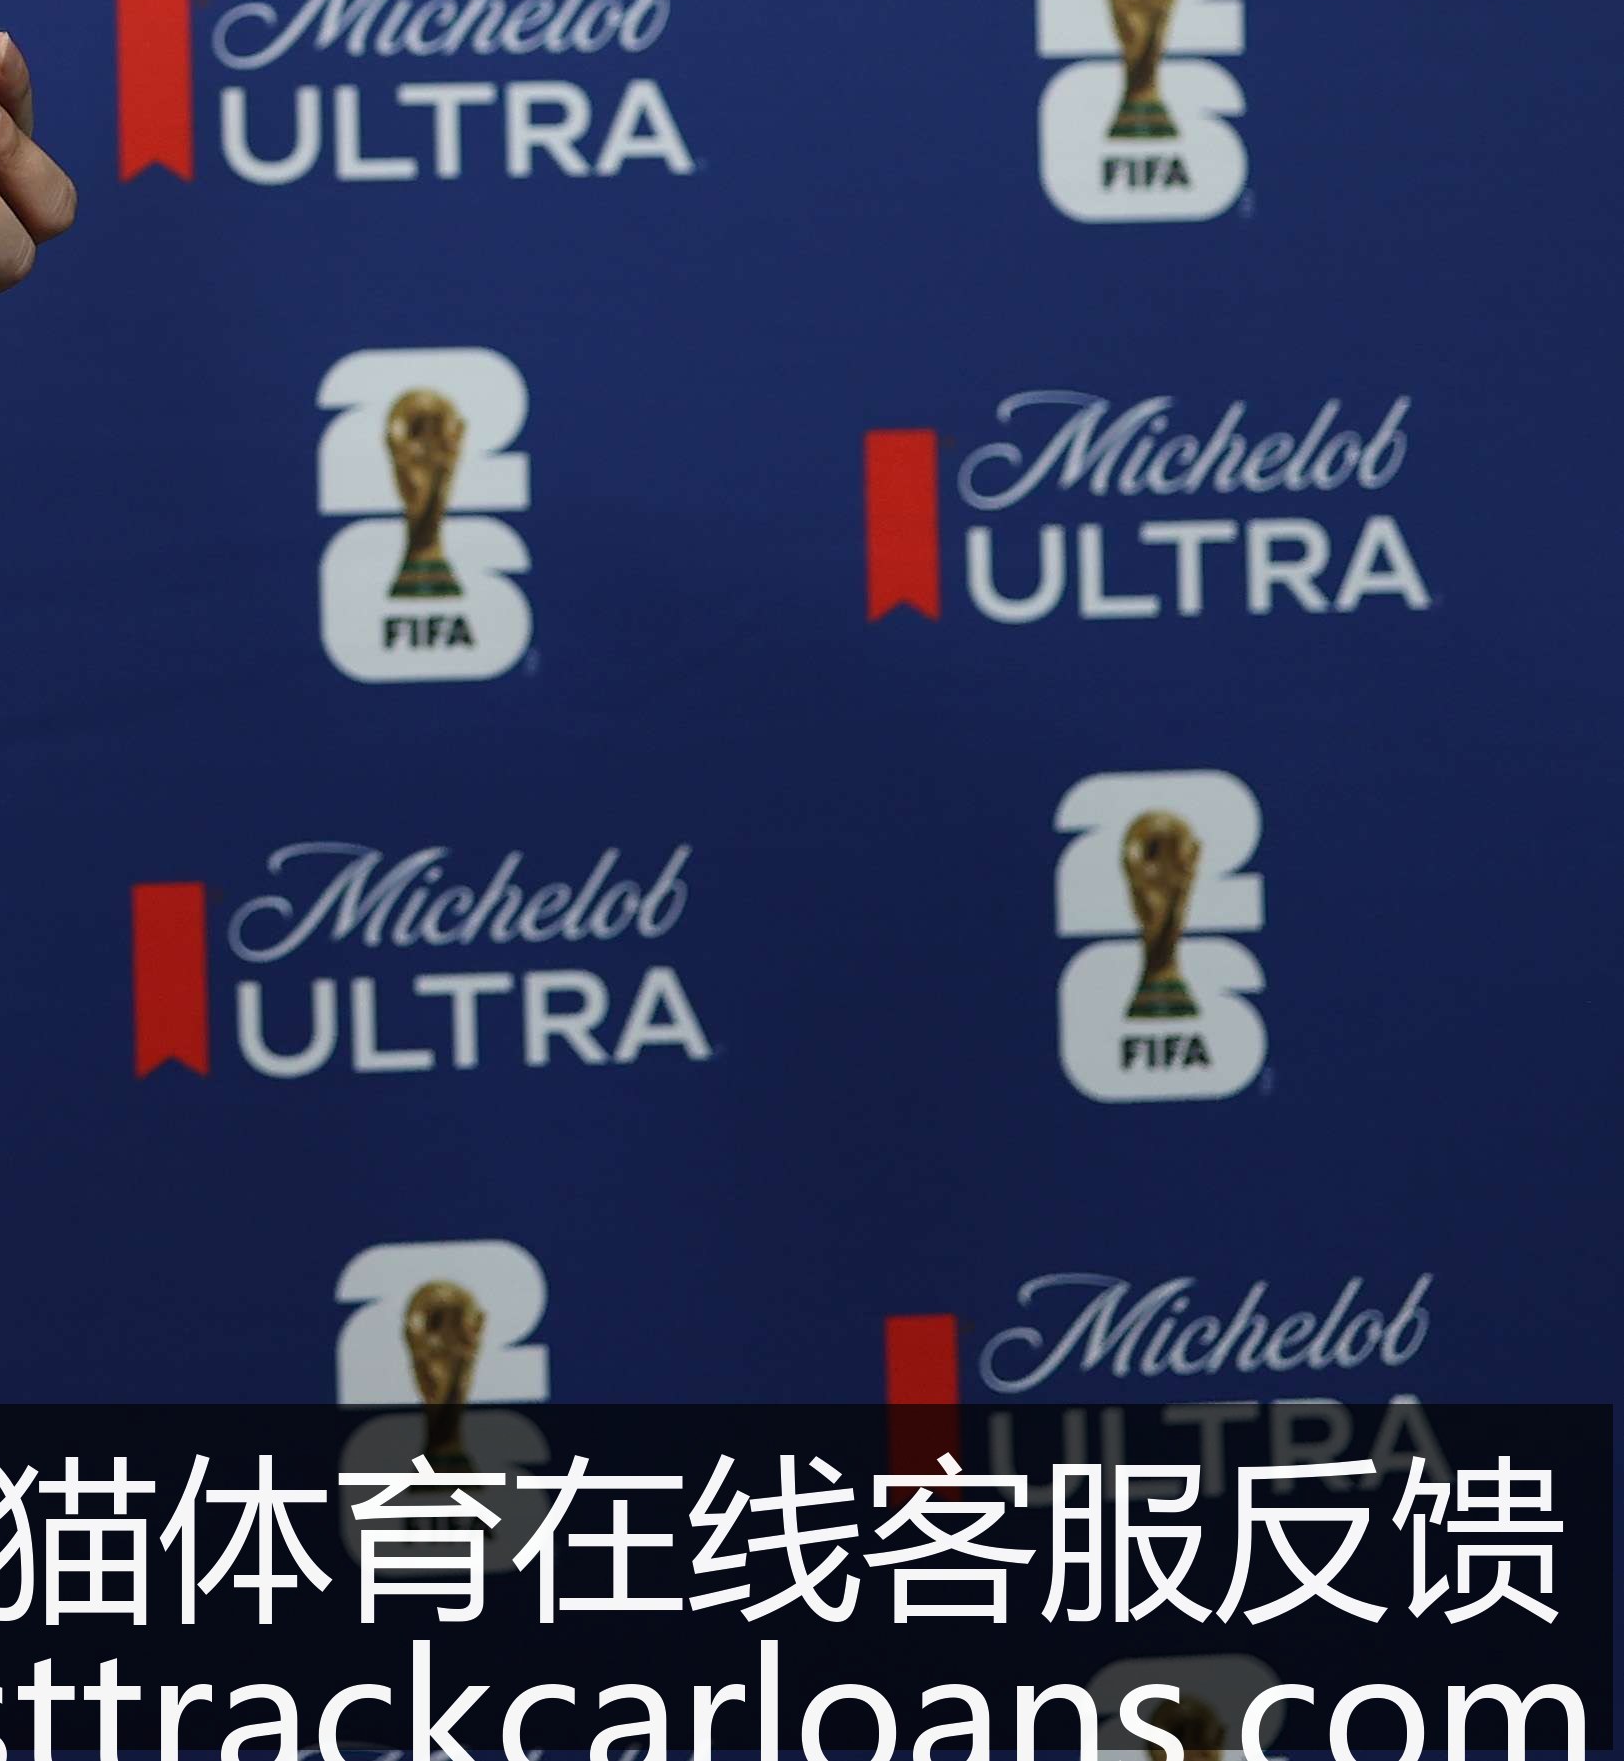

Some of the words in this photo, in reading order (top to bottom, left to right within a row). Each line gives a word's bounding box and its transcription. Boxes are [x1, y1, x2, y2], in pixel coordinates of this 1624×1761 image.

[222, 80, 693, 184] ULTRA
[1103, 158, 1189, 186] FIFA
[958, 391, 1410, 510] Michelob
[967, 516, 1429, 622] ULTRA
[385, 617, 472, 647] FIFA
[229, 842, 692, 962] Michelob
[238, 967, 710, 1077] ULTRA
[1122, 1036, 1209, 1068] FIFA
[981, 1273, 1432, 1396] Michelob
